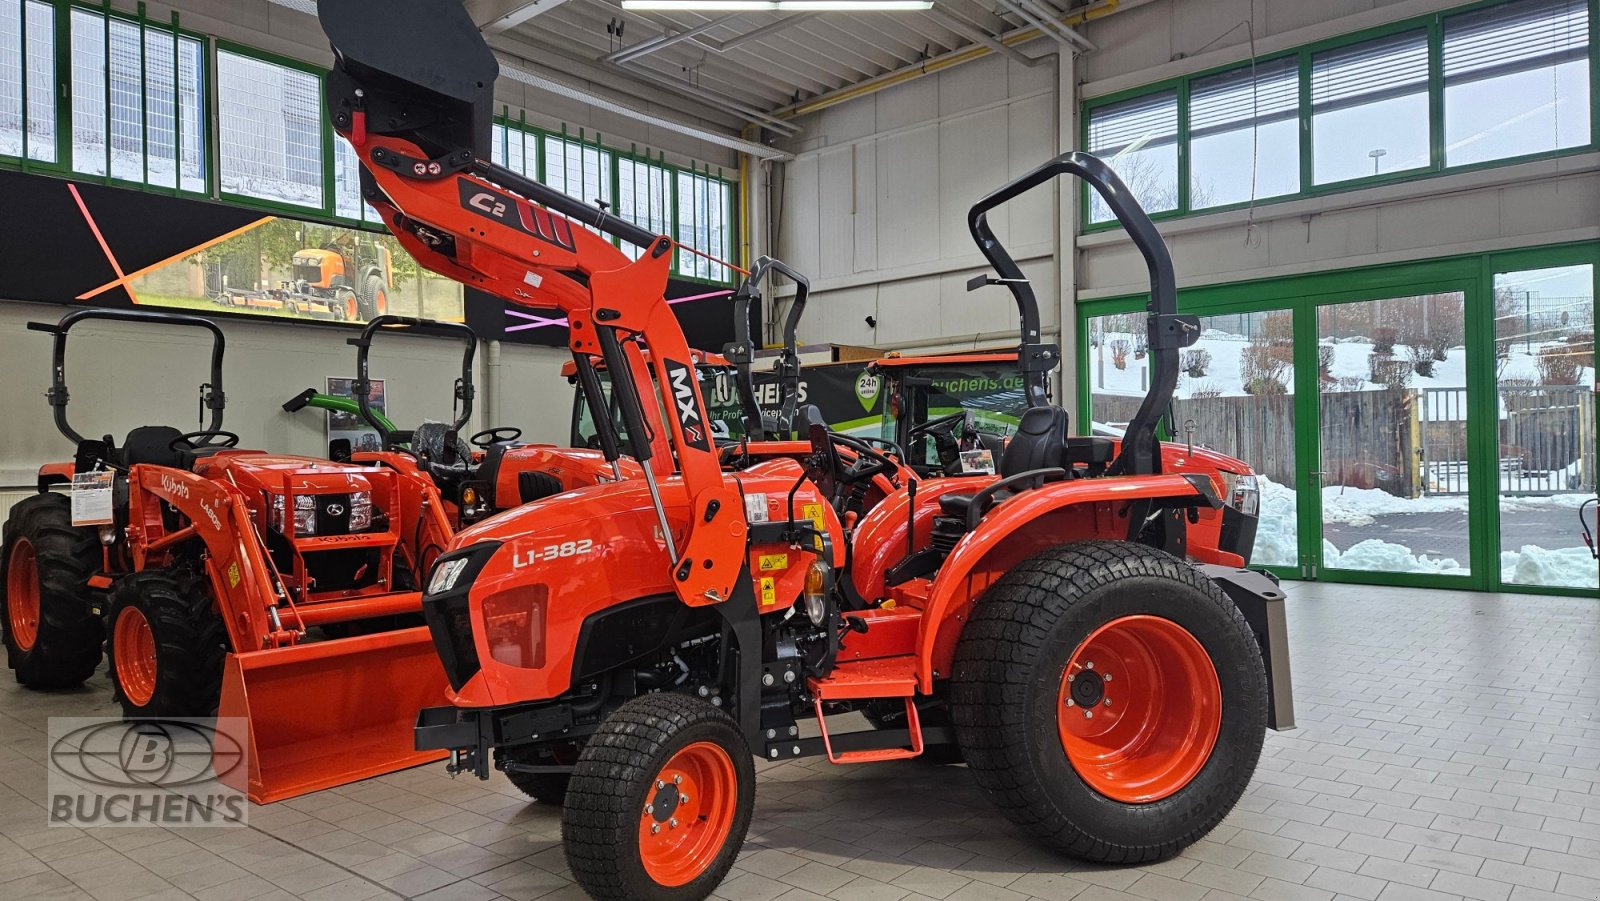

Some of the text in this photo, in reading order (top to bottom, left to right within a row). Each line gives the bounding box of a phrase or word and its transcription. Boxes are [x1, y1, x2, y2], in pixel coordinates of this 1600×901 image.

[469, 192, 506, 218] C2
[669, 367, 699, 424] MX
[860, 378, 877, 388] 24h
[161, 474, 190, 499] Kubota
[200, 498, 222, 531] LA805
[512, 538, 593, 568] L1-382
